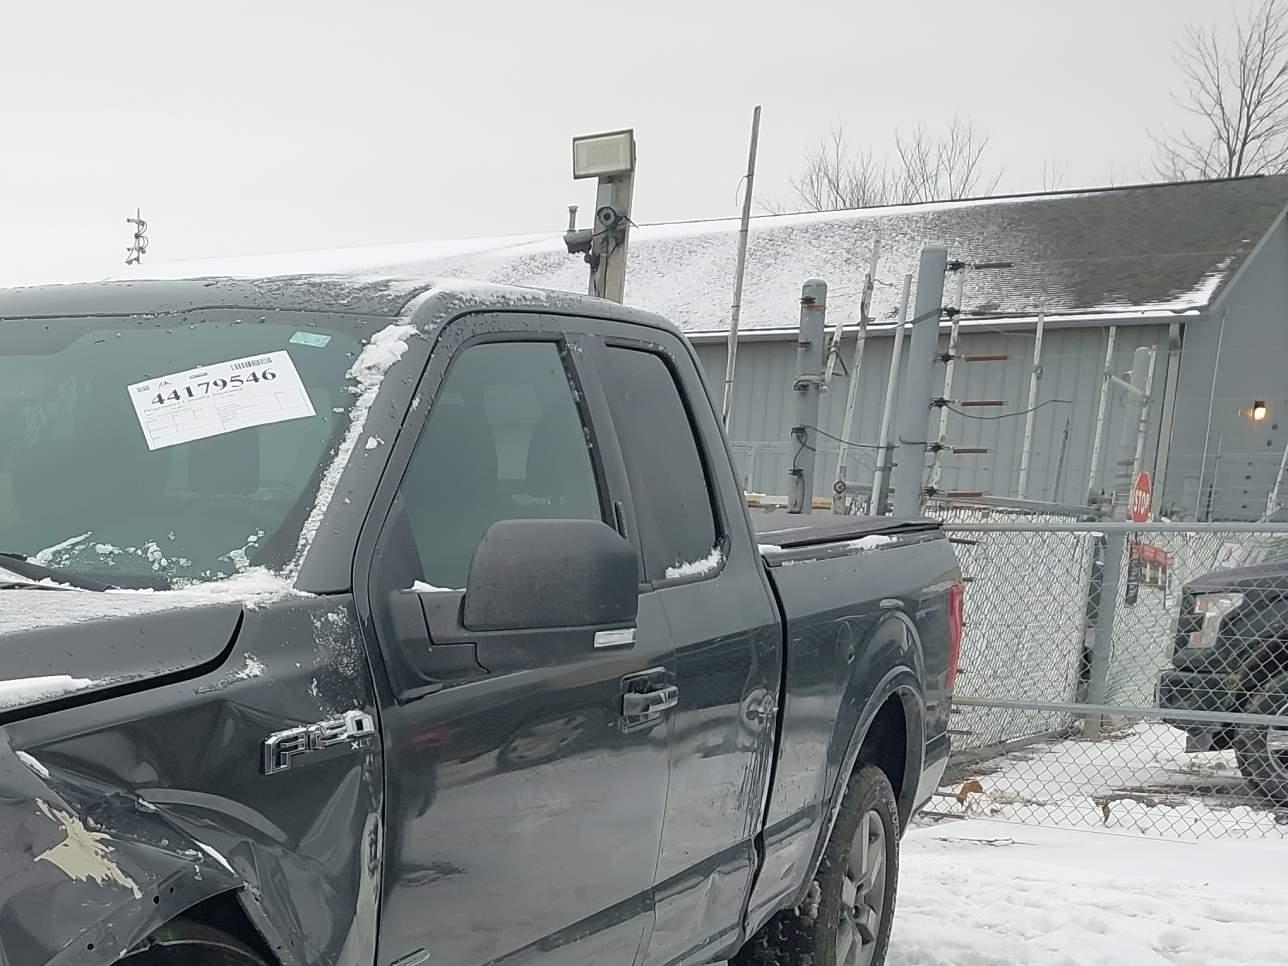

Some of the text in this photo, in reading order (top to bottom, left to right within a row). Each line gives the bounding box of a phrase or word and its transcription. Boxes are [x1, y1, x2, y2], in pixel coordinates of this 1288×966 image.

[151, 367, 277, 405] 44179546
[1133, 489, 1150, 515] STOP
[350, 737, 371, 751] XLT
